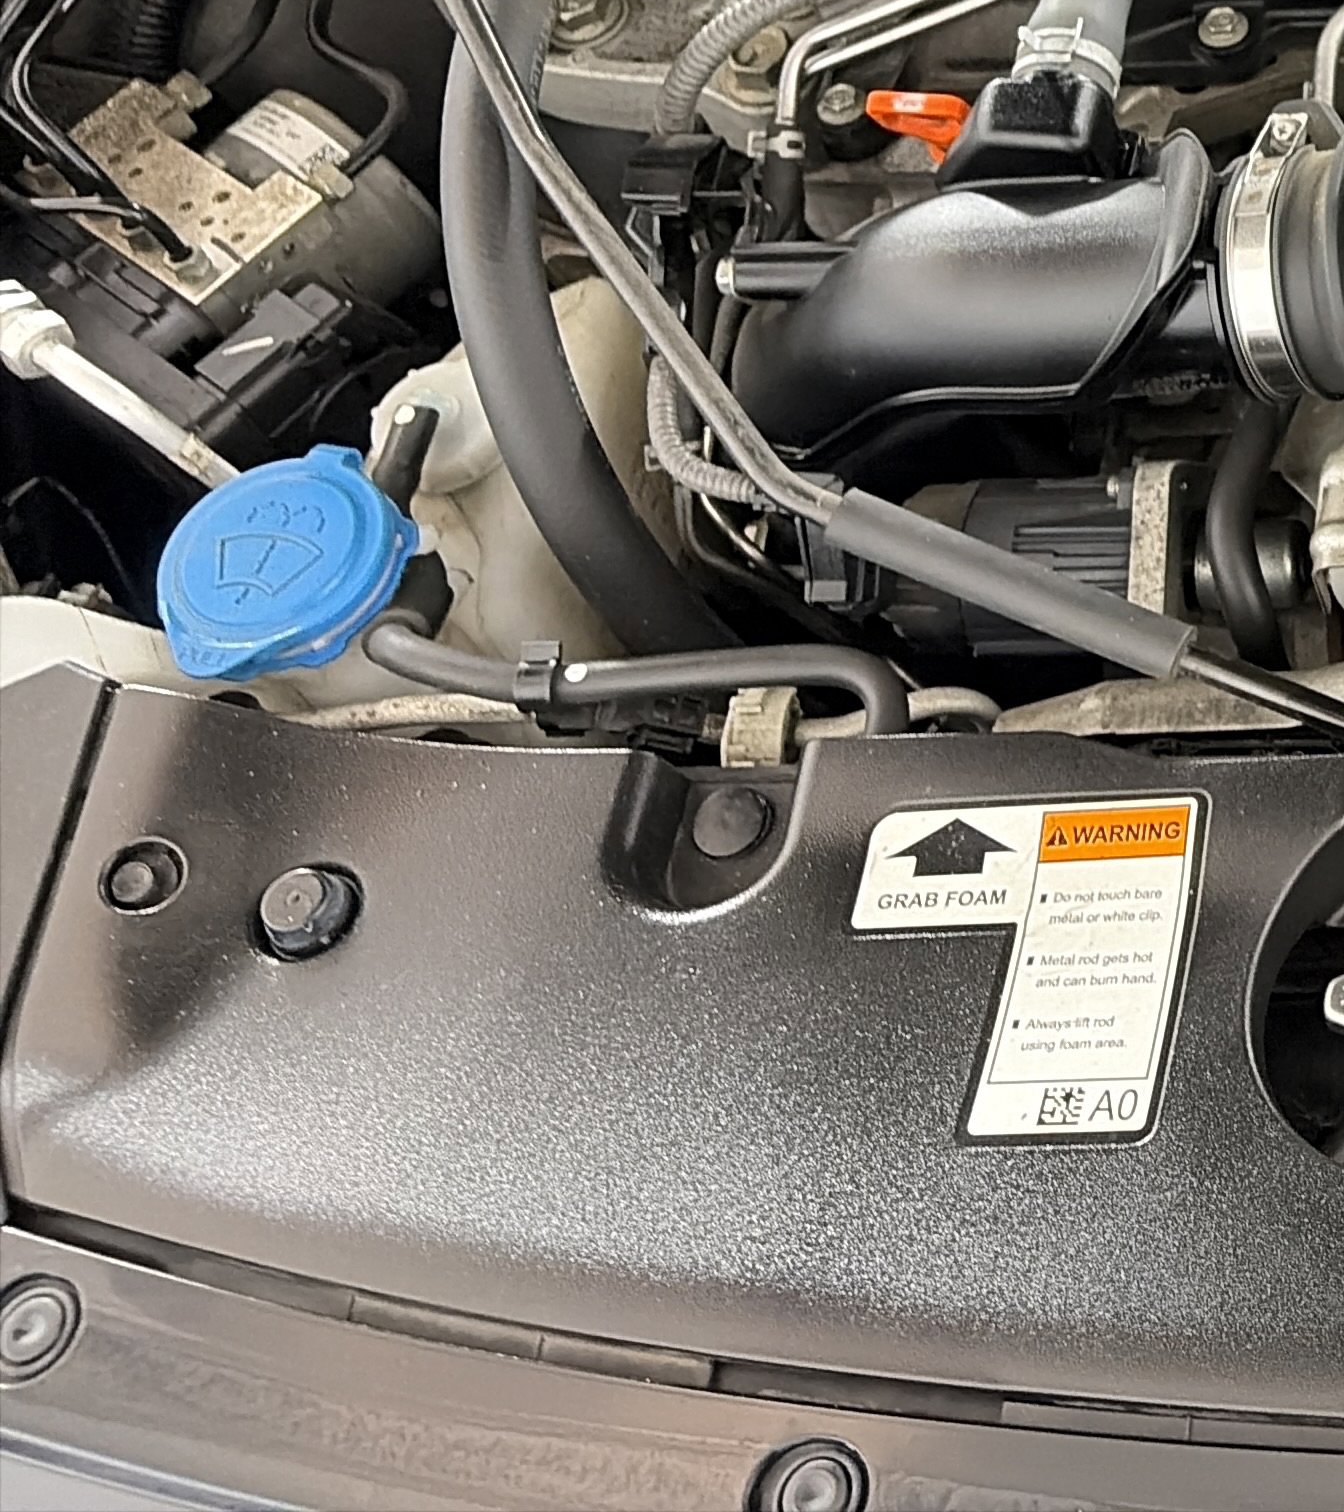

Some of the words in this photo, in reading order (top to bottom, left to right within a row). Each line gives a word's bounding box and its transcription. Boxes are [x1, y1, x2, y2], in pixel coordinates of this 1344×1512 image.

[1073, 821, 1181, 845] WARNING
[878, 891, 939, 909] GRAB
[944, 889, 1007, 907] FOAM
[1053, 891, 1071, 903] Do
[1074, 891, 1095, 903] not
[1098, 889, 1131, 902] touch
[1134, 888, 1162, 900] bare
[1049, 912, 1083, 925] metal
[1086, 914, 1100, 923] or
[1103, 911, 1135, 923] white
[1139, 909, 1163, 923] clip.
[1040, 954, 1075, 966] Metal
[1078, 953, 1099, 965] rod
[1102, 952, 1129, 967] gets
[1133, 951, 1153, 963] hot
[1035, 975, 1060, 988] and
[1063, 976, 1086, 987] can
[1122, 972, 1157, 985] hand.
[1025, 1018, 1071, 1032] Always
[1074, 1017, 1090, 1028] lift
[1093, 1016, 1116, 1028] rod
[1021, 1039, 1056, 1053] using
[1059, 1038, 1091, 1050] foam
[1095, 1039, 1127, 1050] area.
[1088, 1089, 1139, 1121] A0
